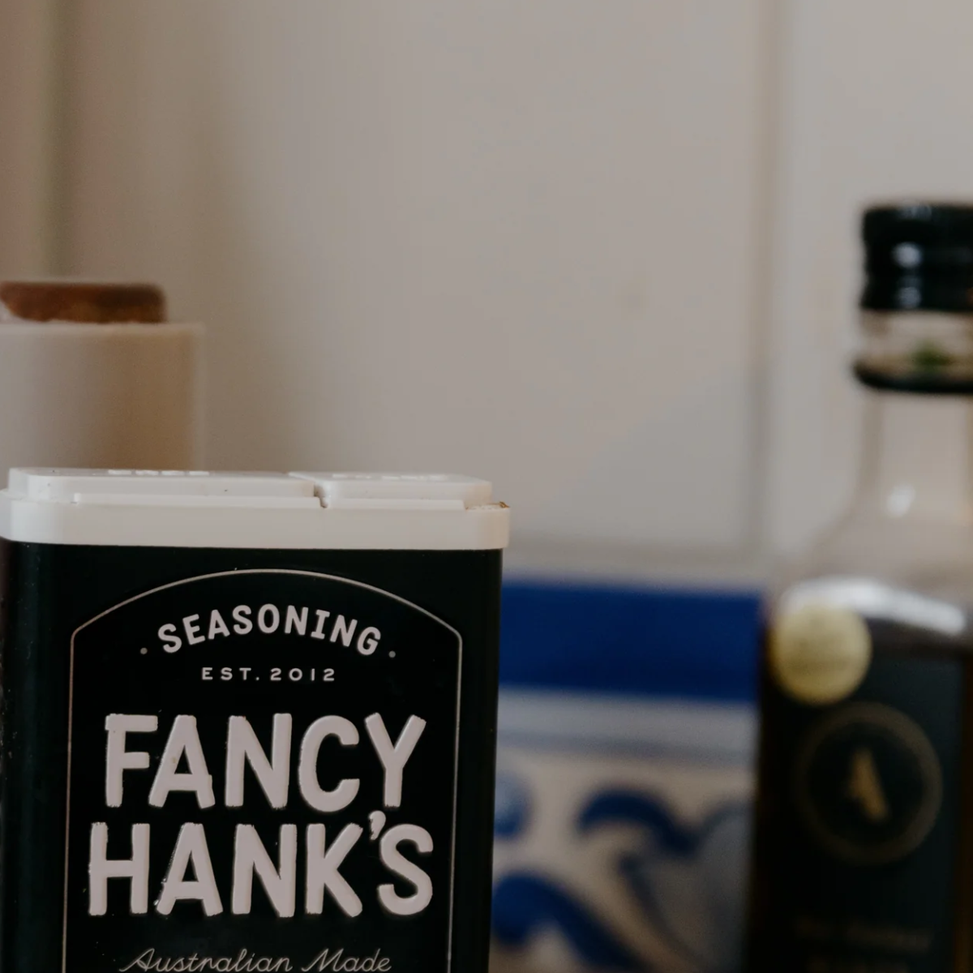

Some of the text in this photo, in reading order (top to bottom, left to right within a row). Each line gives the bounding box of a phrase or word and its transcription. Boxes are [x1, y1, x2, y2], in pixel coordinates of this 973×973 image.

[157, 603, 382, 656] SEASONING
[270, 667, 335, 682] 2012
[104, 712, 427, 813] FANCY
[87, 810, 434, 919] HANK'S
[118, 947, 393, 973] Australian Made
